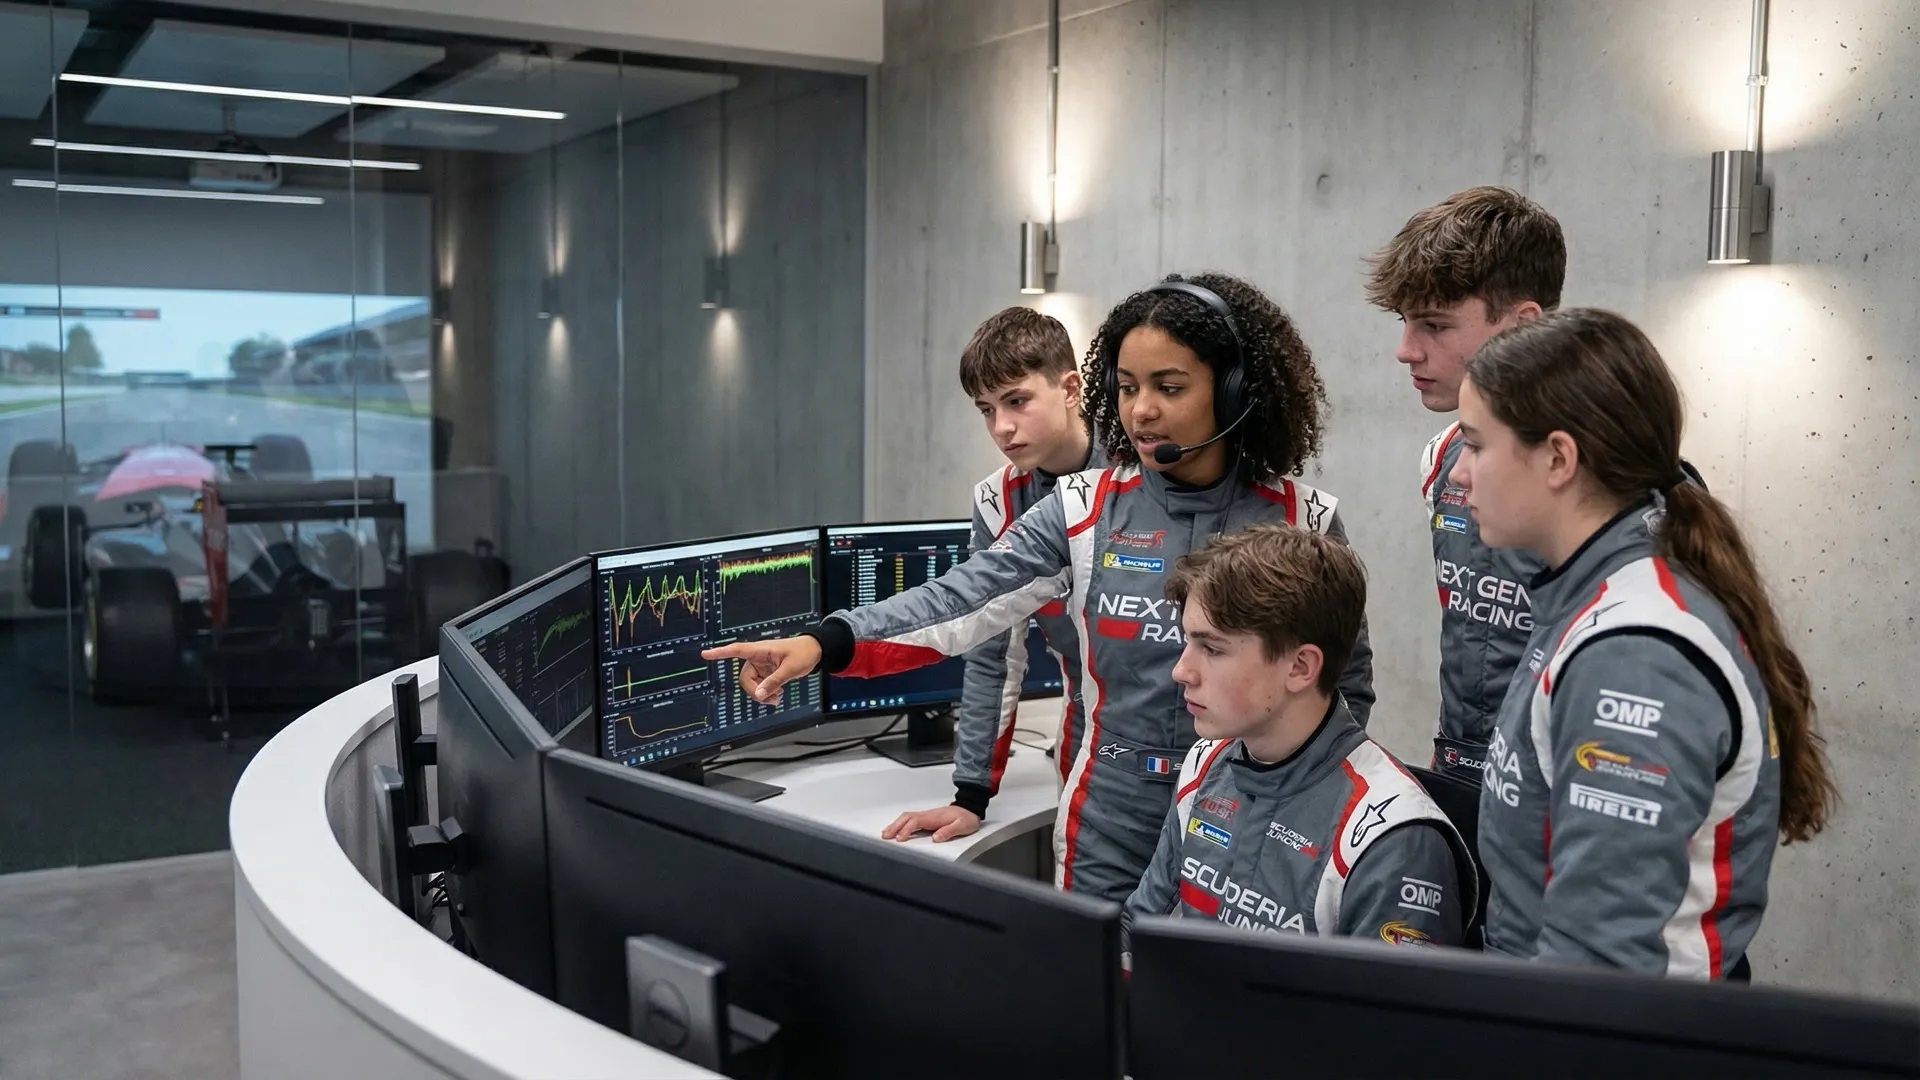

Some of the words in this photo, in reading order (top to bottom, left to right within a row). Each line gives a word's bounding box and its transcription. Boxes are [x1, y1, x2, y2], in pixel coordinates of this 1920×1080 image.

[1098, 592, 1181, 620] NEXT
[1477, 575, 1532, 608] GEN
[1448, 590, 1535, 631] RACING
[1141, 623, 1188, 644] RA
[1596, 697, 1662, 728] OMP
[1569, 782, 1662, 827] PIRELLI
[1180, 856, 1306, 936] SCUDERIA
[1400, 883, 1442, 908] OMP
